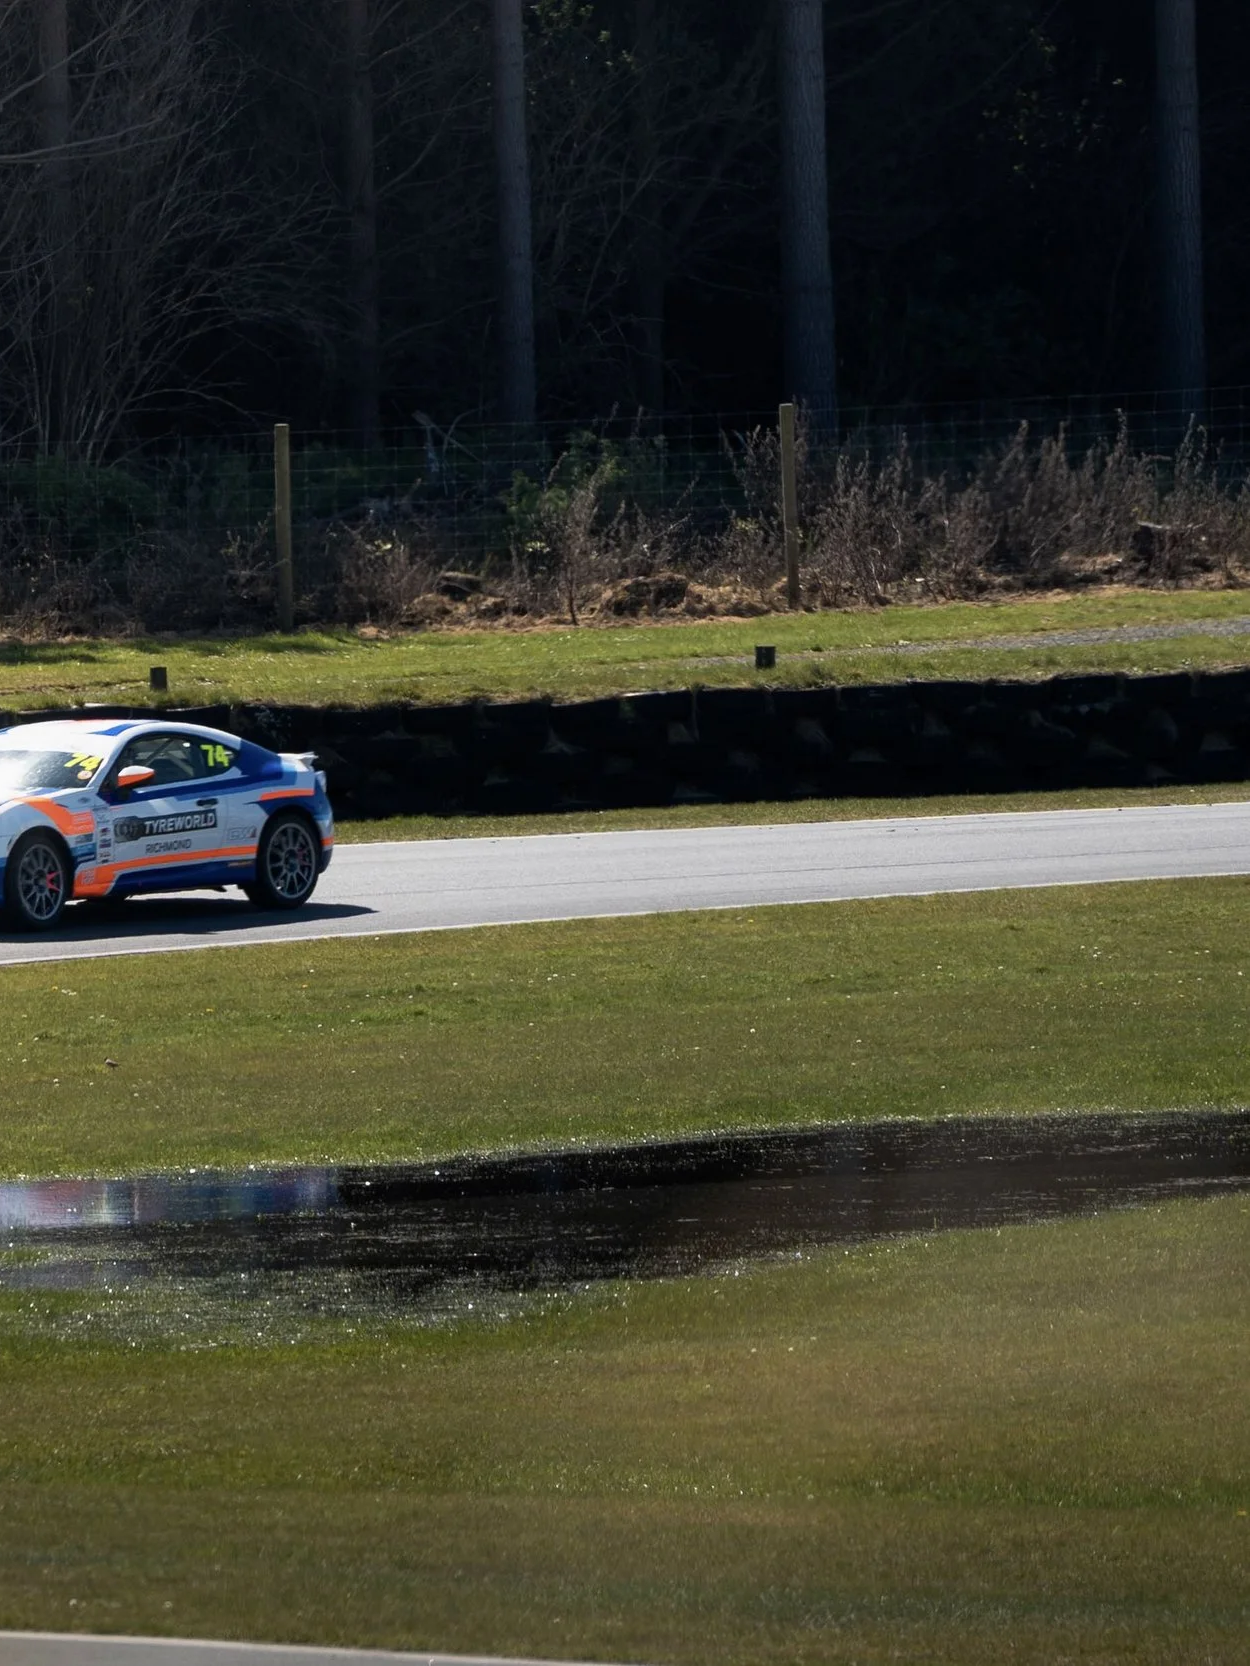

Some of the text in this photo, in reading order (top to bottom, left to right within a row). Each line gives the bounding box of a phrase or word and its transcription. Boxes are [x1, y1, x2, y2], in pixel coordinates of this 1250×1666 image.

[64, 753, 102, 770] 74
[200, 744, 229, 767] 74
[144, 813, 216, 834] TYREWORLD
[145, 839, 192, 853] RICHMOND
